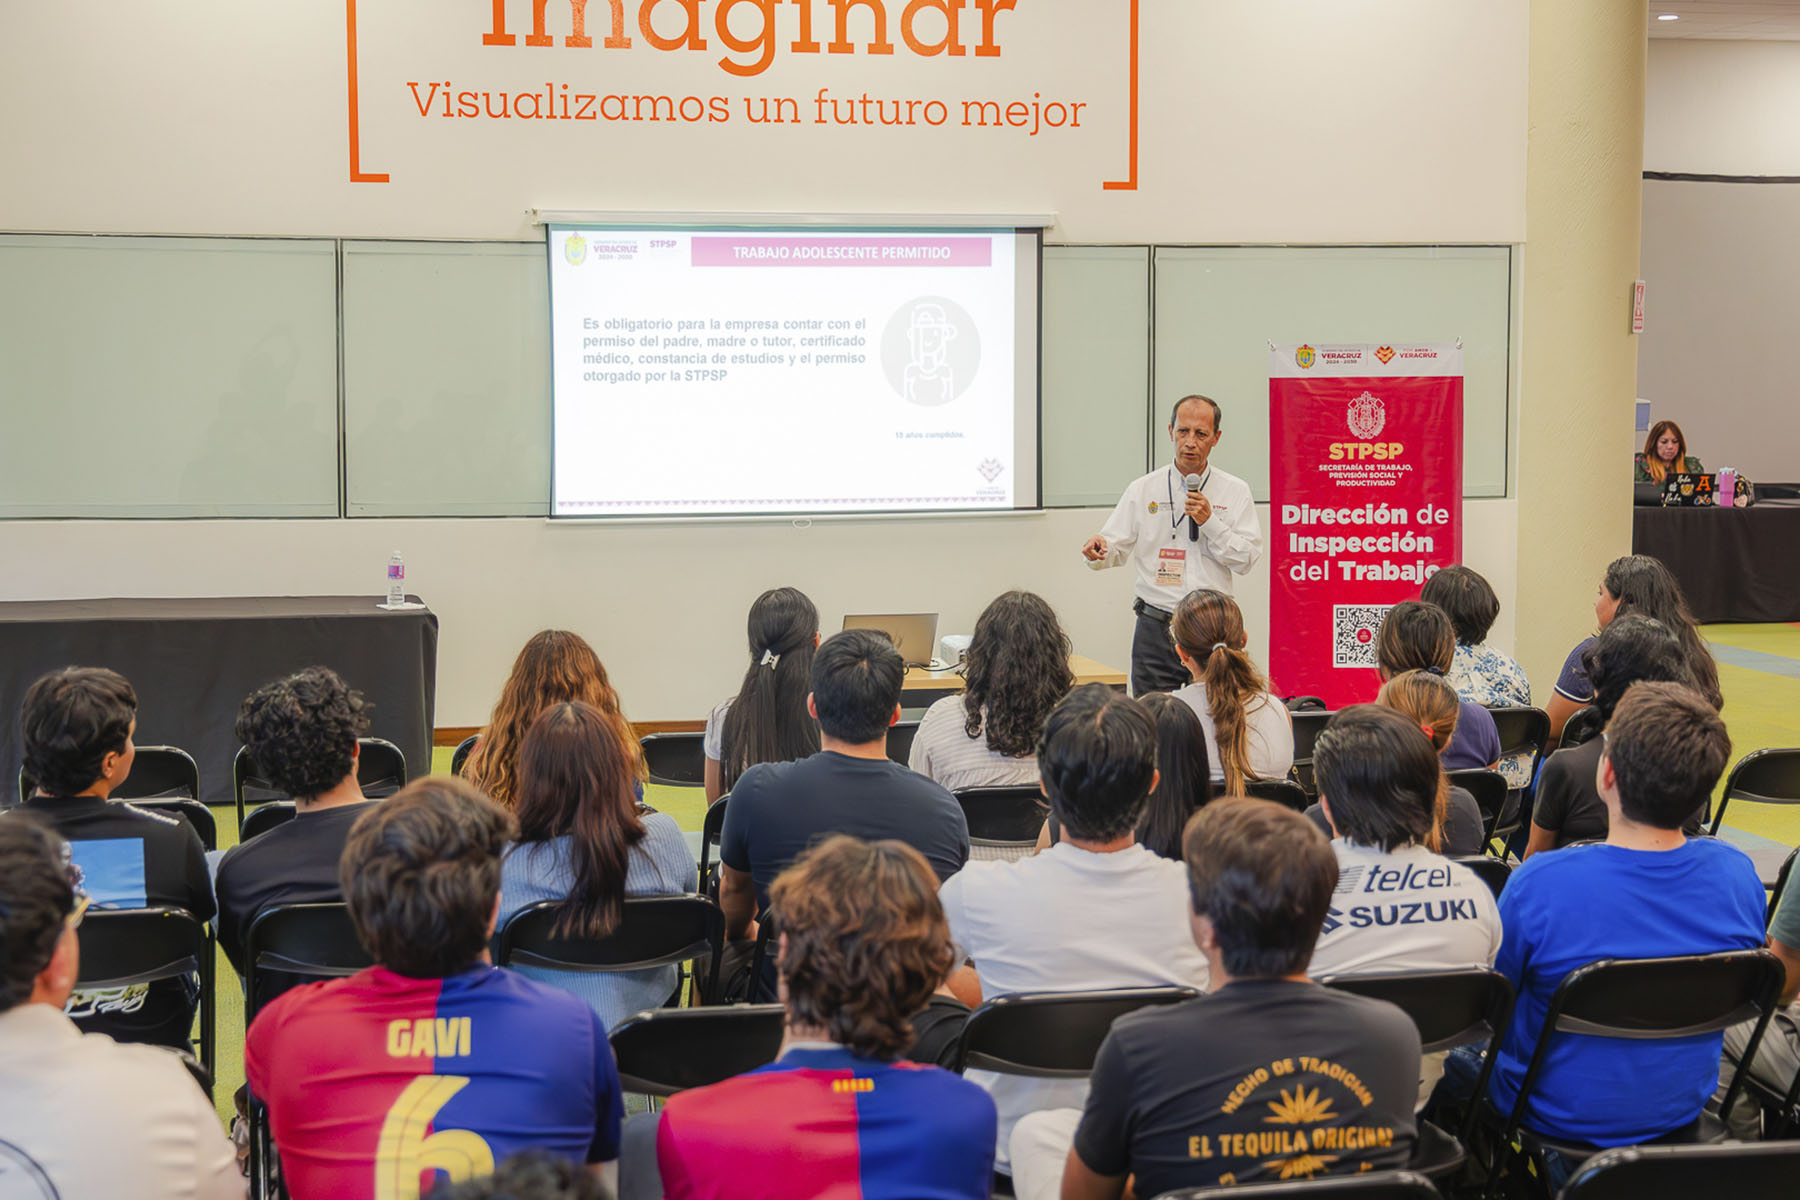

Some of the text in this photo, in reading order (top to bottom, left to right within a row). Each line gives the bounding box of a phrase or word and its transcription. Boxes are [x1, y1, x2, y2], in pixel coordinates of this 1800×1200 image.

[407, 81, 1086, 136] Visualizamos un futuro mejor
[649, 240, 677, 248] STPSP
[733, 246, 950, 259] TRABAJO ADOLESCENTE PERMITIDO
[583, 318, 866, 332] Es obligatorio para la empresa contar con el
[583, 335, 866, 350] permiso del padre, madre o tutor, certificado
[583, 352, 866, 367] médico, constancia de estudios y el permiso
[583, 370, 728, 384] otorgado por la STPSP
[1329, 442, 1404, 460] STPSP
[1282, 502, 1449, 524] Dirección de
[1290, 531, 1434, 557] Inspección
[1290, 560, 1329, 581] del
[1364, 863, 1452, 893] telcel
[1350, 899, 1478, 928] SUZUKI
[386, 1016, 472, 1057] GAVI
[1272, 1058, 1295, 1076] DE
[374, 1075, 495, 1200] 6
[1188, 1135, 1213, 1158] EL
[1218, 1130, 1309, 1158] TEQUILA
